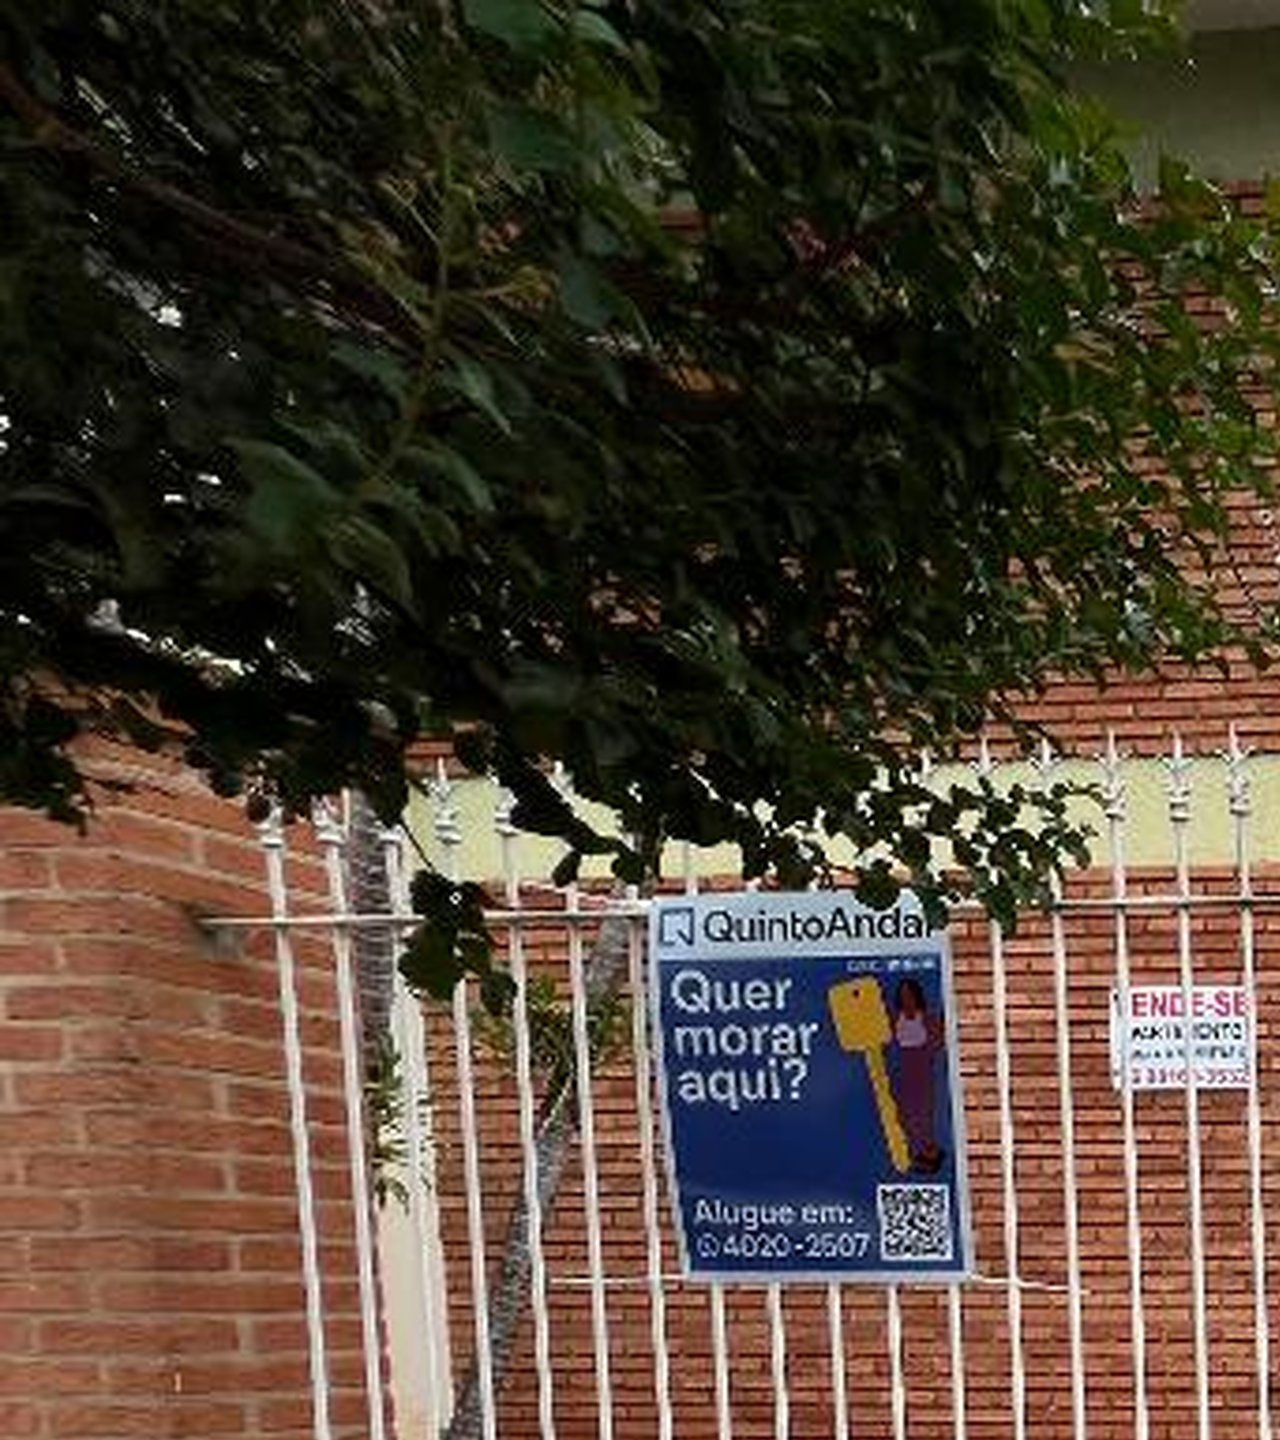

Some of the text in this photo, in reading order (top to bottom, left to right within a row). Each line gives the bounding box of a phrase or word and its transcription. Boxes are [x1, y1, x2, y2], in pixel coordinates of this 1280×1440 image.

[670, 970, 793, 1014] Quer
[1131, 990, 1247, 1018] ENDE-SE
[673, 1022, 819, 1057] morar
[677, 1059, 808, 1110] aqui?
[694, 1198, 854, 1230] Alugue em:
